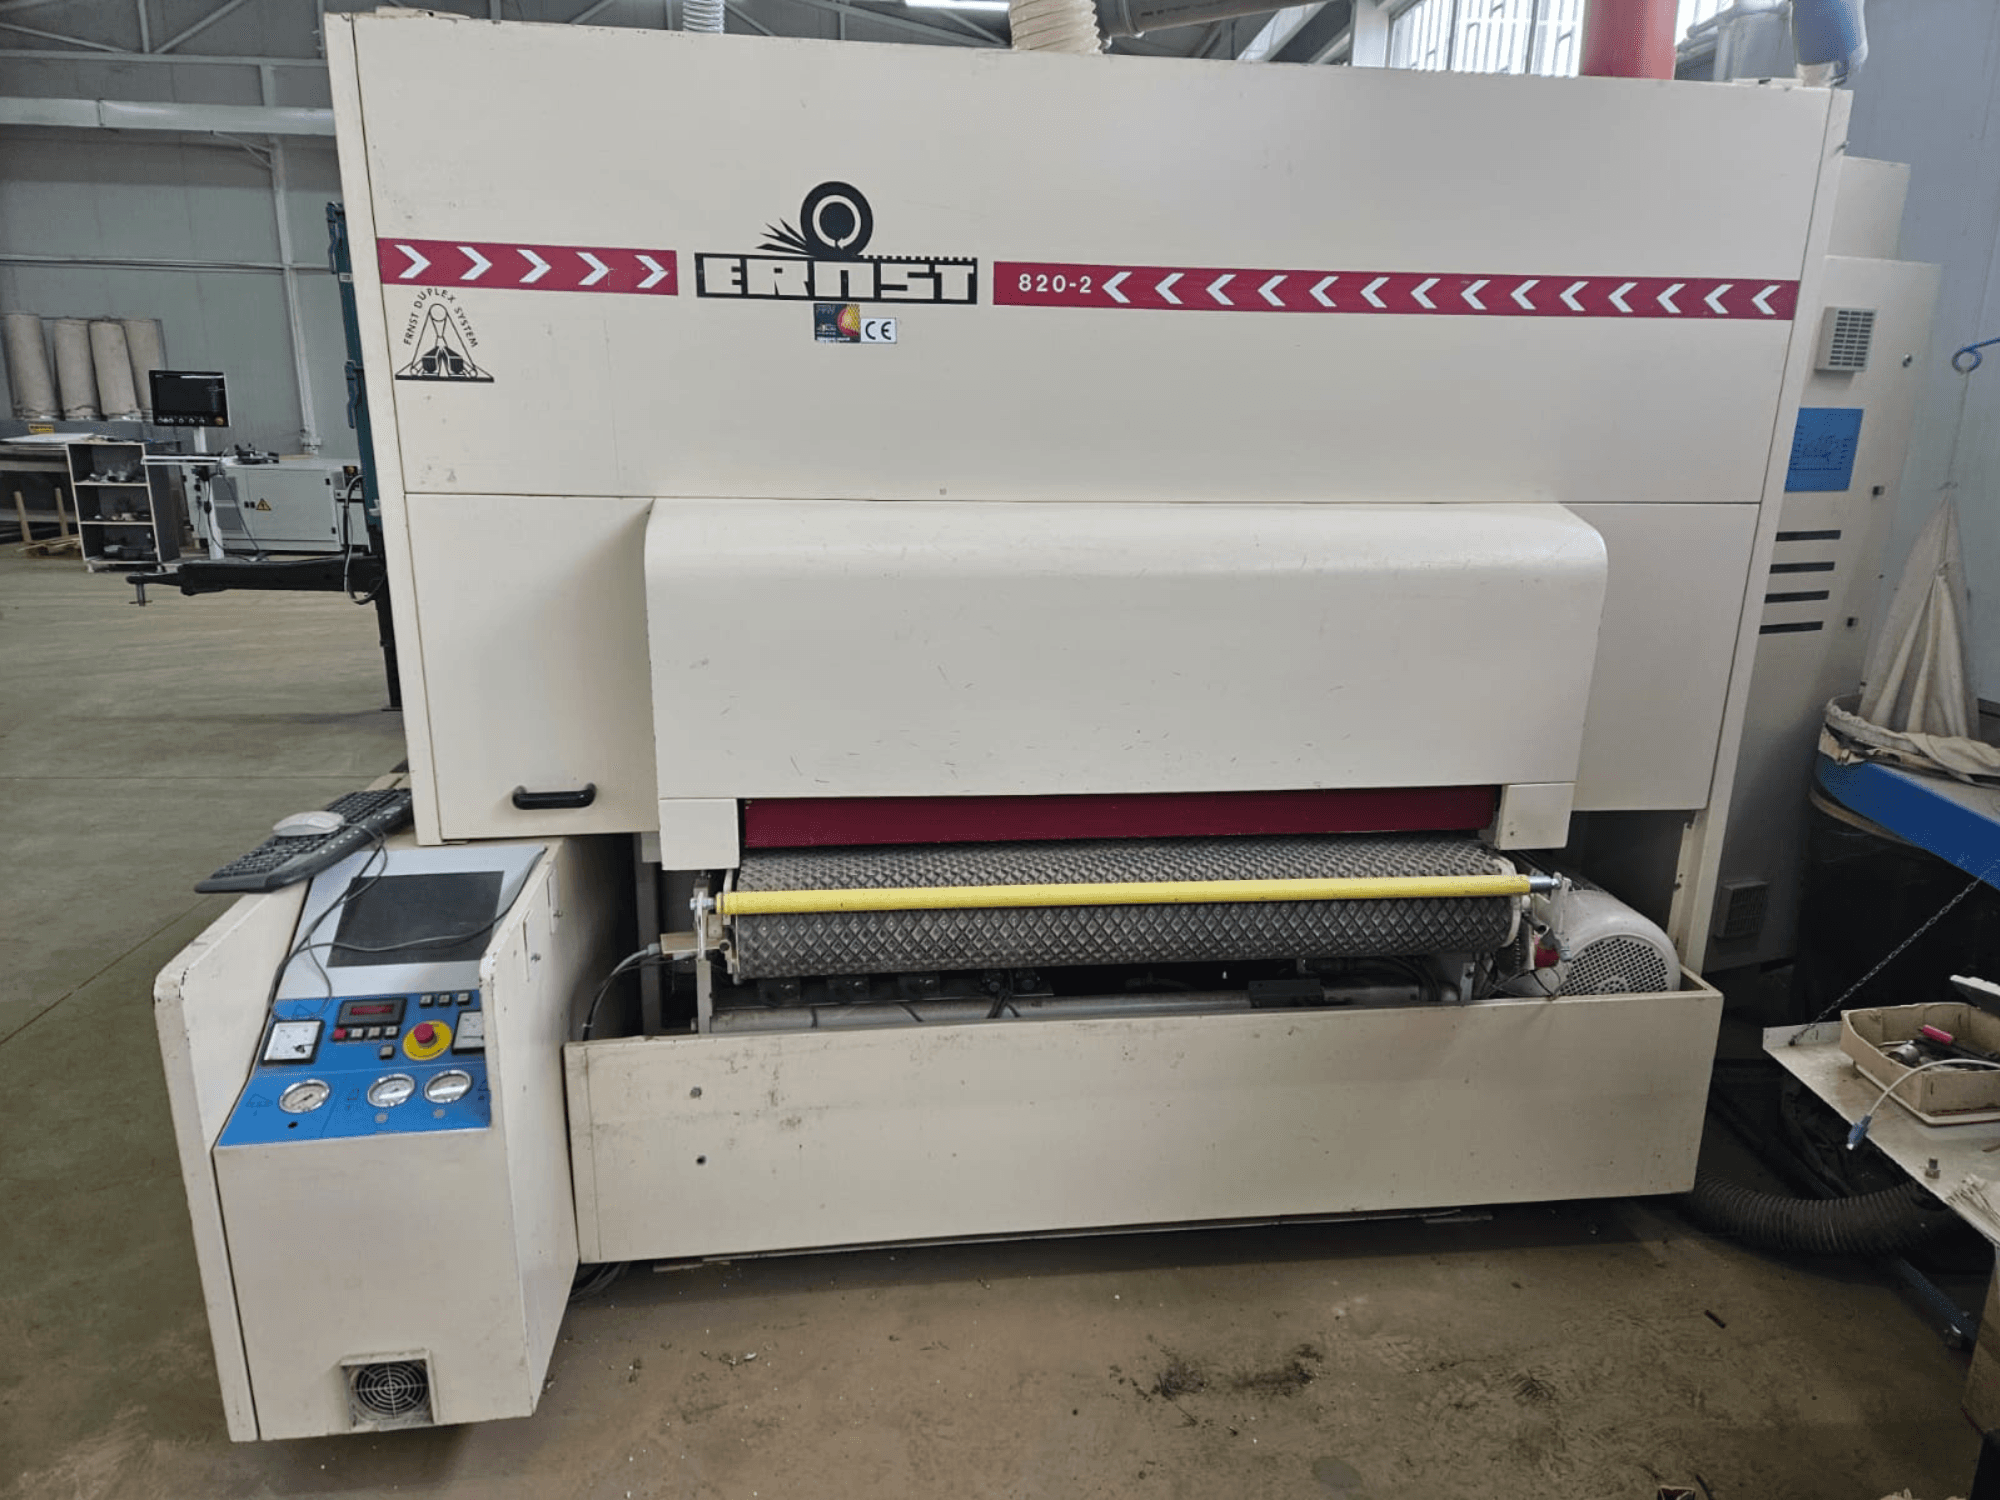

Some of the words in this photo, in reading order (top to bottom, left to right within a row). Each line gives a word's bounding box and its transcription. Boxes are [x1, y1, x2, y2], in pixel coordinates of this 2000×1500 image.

[702, 256, 975, 301] ERNST
[1018, 273, 1092, 294] 820-2
[413, 287, 457, 310] DUPLEX
[453, 306, 479, 348] SYSTEM
[865, 320, 892, 341] CE
